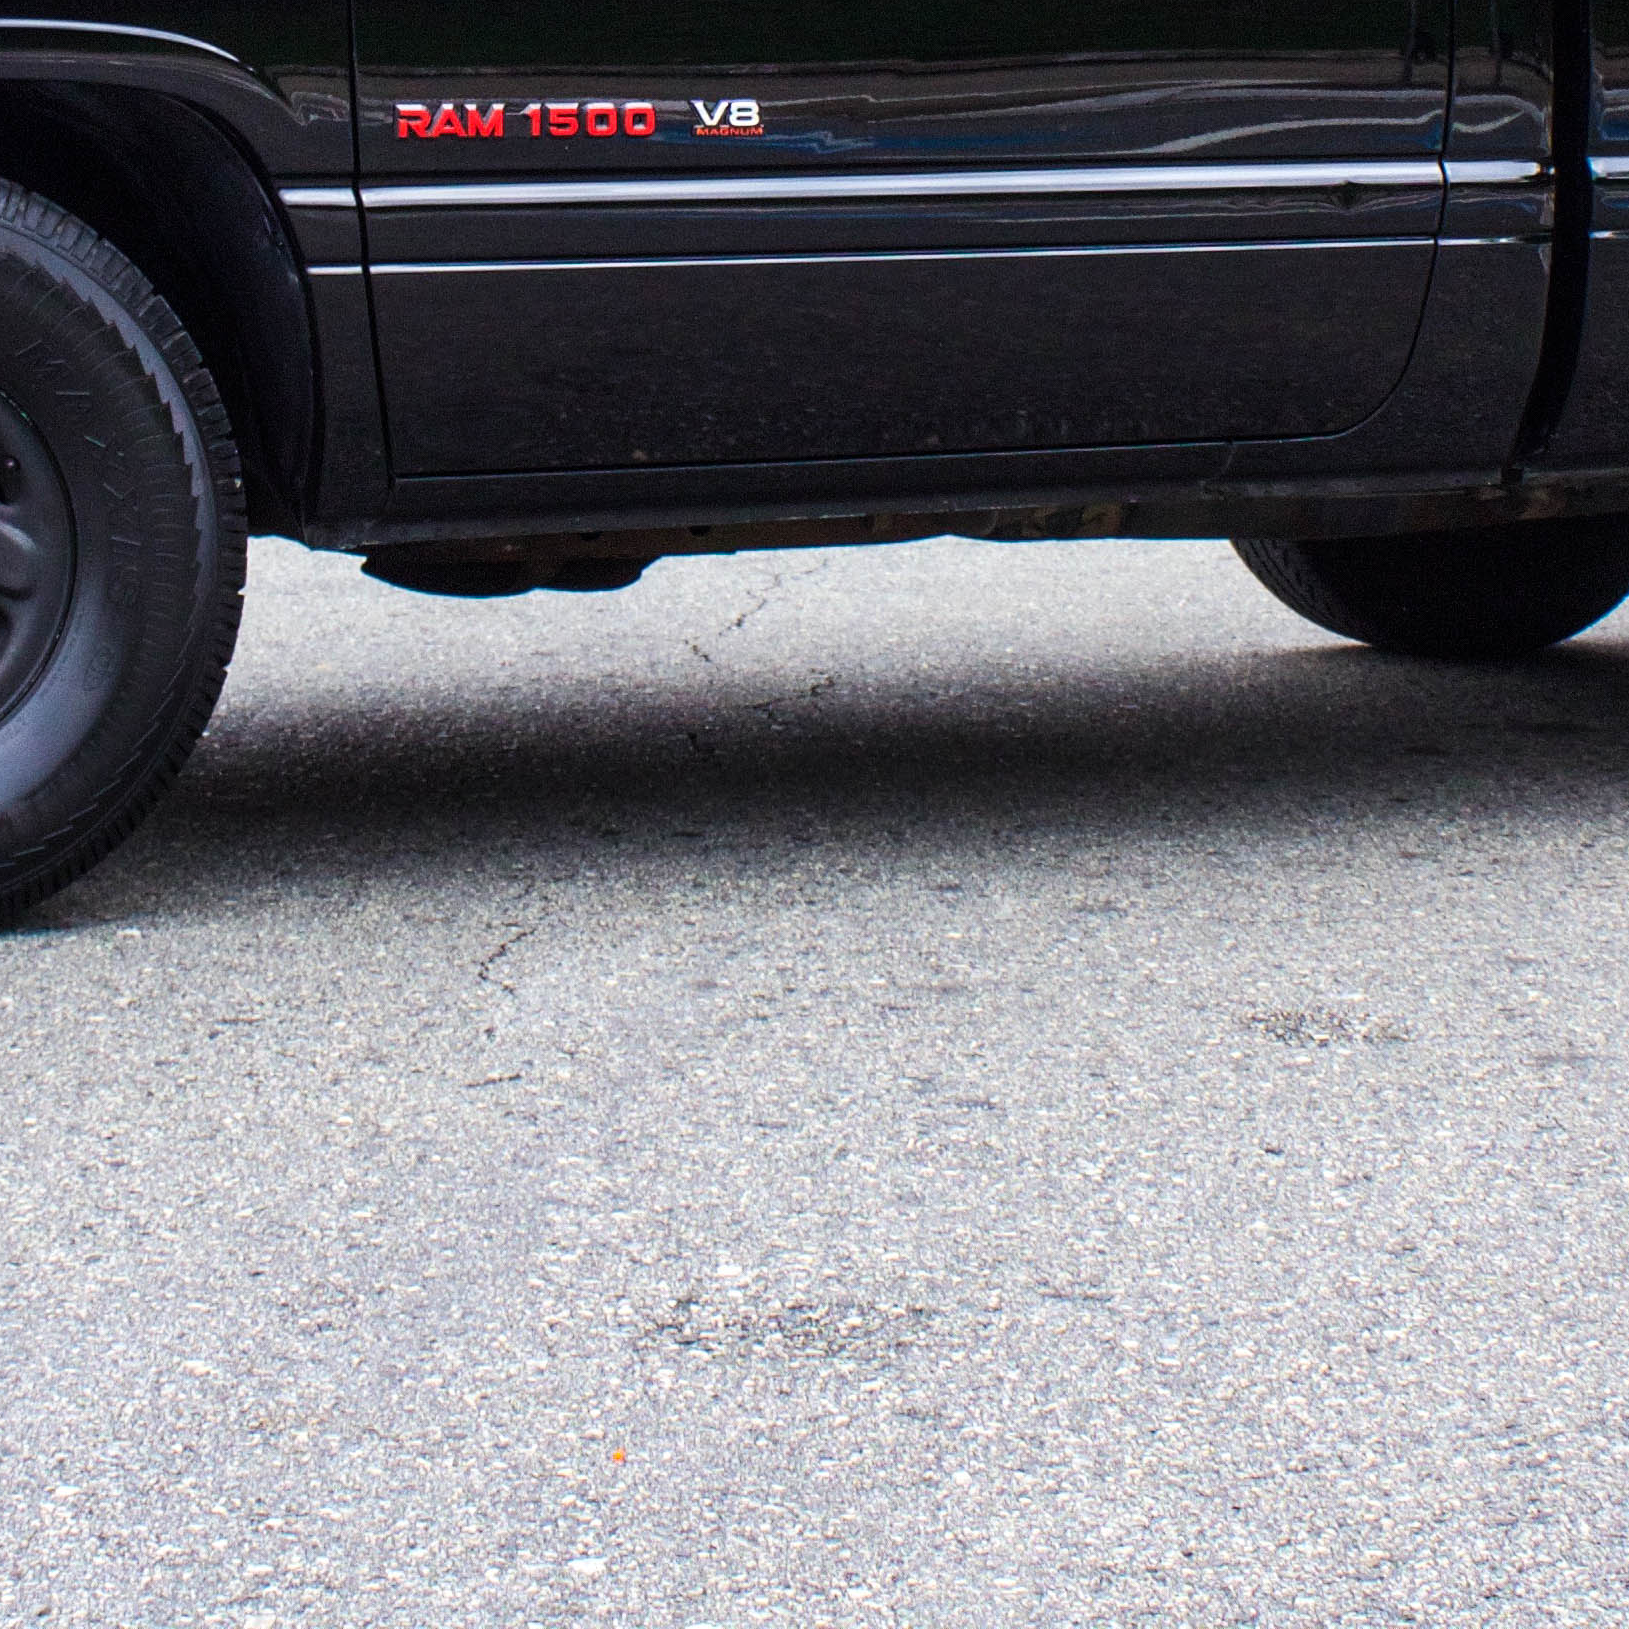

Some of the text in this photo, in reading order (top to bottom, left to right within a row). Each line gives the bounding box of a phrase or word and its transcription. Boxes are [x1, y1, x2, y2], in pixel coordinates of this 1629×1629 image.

[395, 99, 761, 139] RAM 1500 V8
[695, 126, 764, 137] MAGNUM
